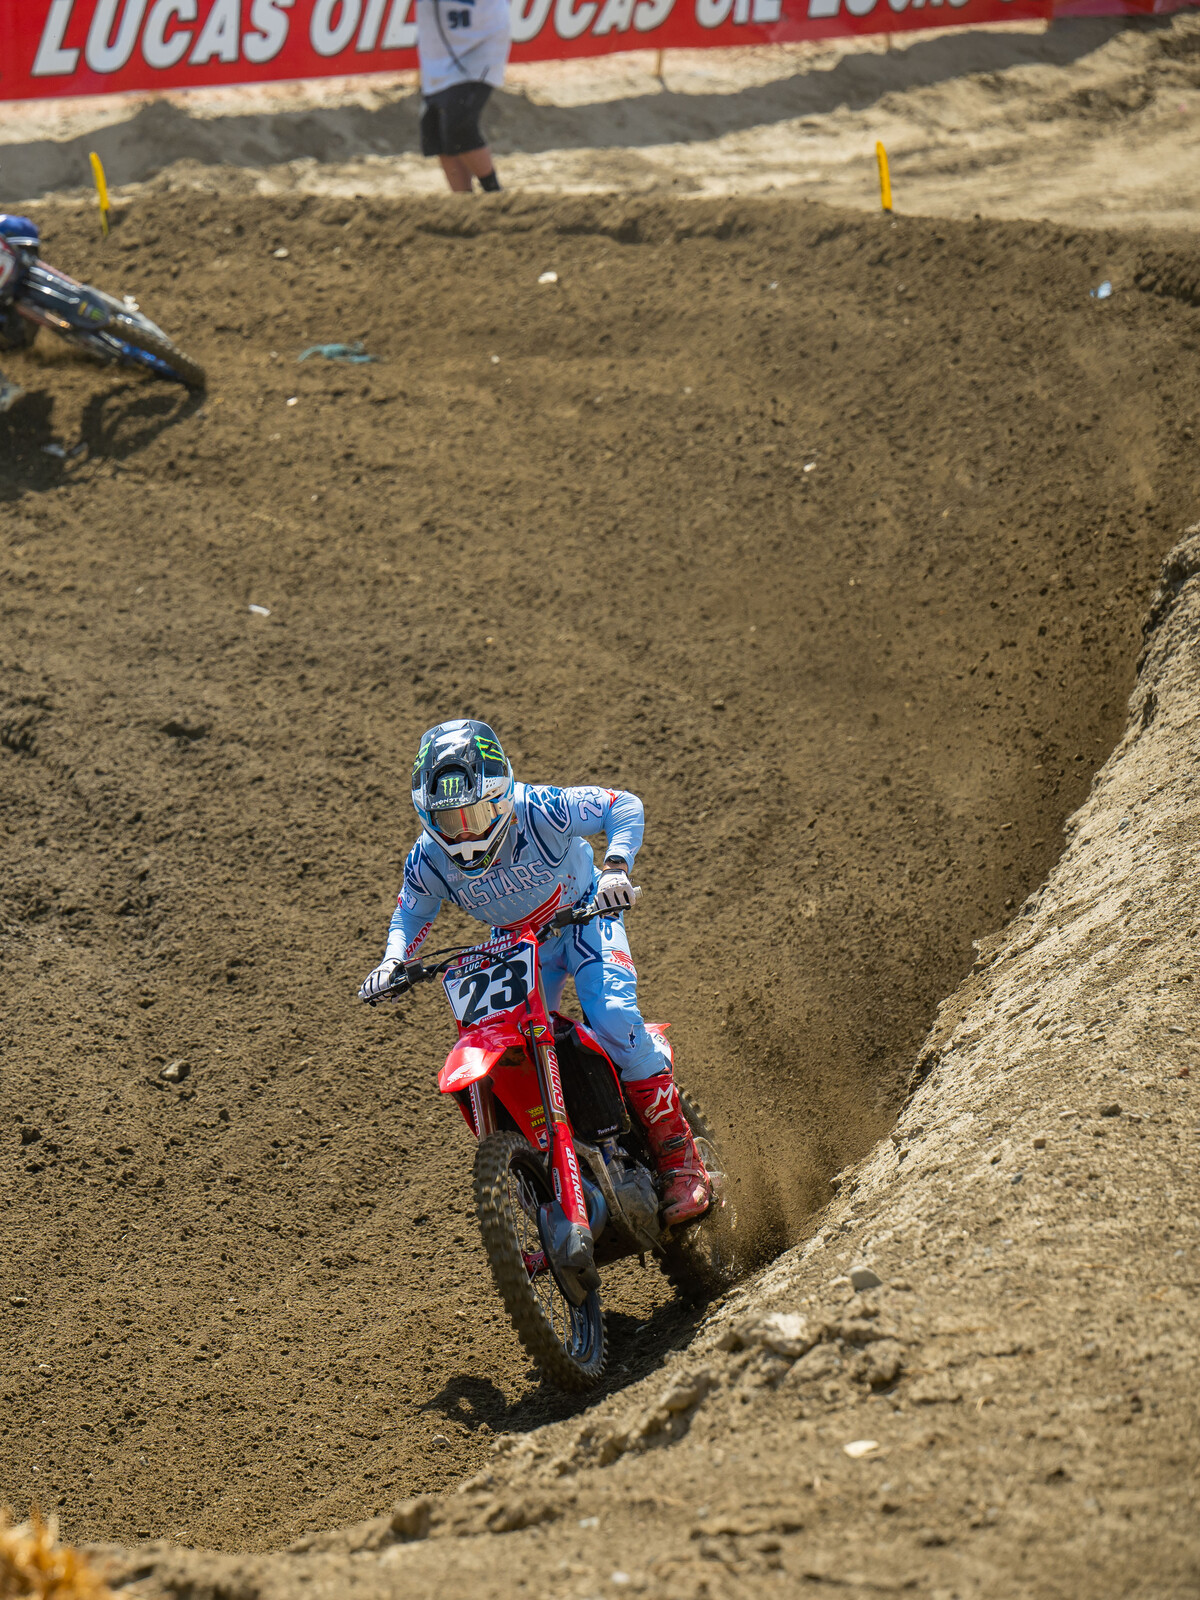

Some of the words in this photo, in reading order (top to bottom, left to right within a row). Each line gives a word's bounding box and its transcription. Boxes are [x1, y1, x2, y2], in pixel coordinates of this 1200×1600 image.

[30, 0, 296, 77] LUCAS
[308, 0, 419, 57] OIL
[457, 859, 555, 911] ASTARS
[461, 941, 512, 965] RENHAL
[464, 957, 490, 974] LUC
[458, 959, 529, 1028] 23
[481, 1010, 506, 1023] HONDA
[565, 1146, 586, 1217] DUNLOP
